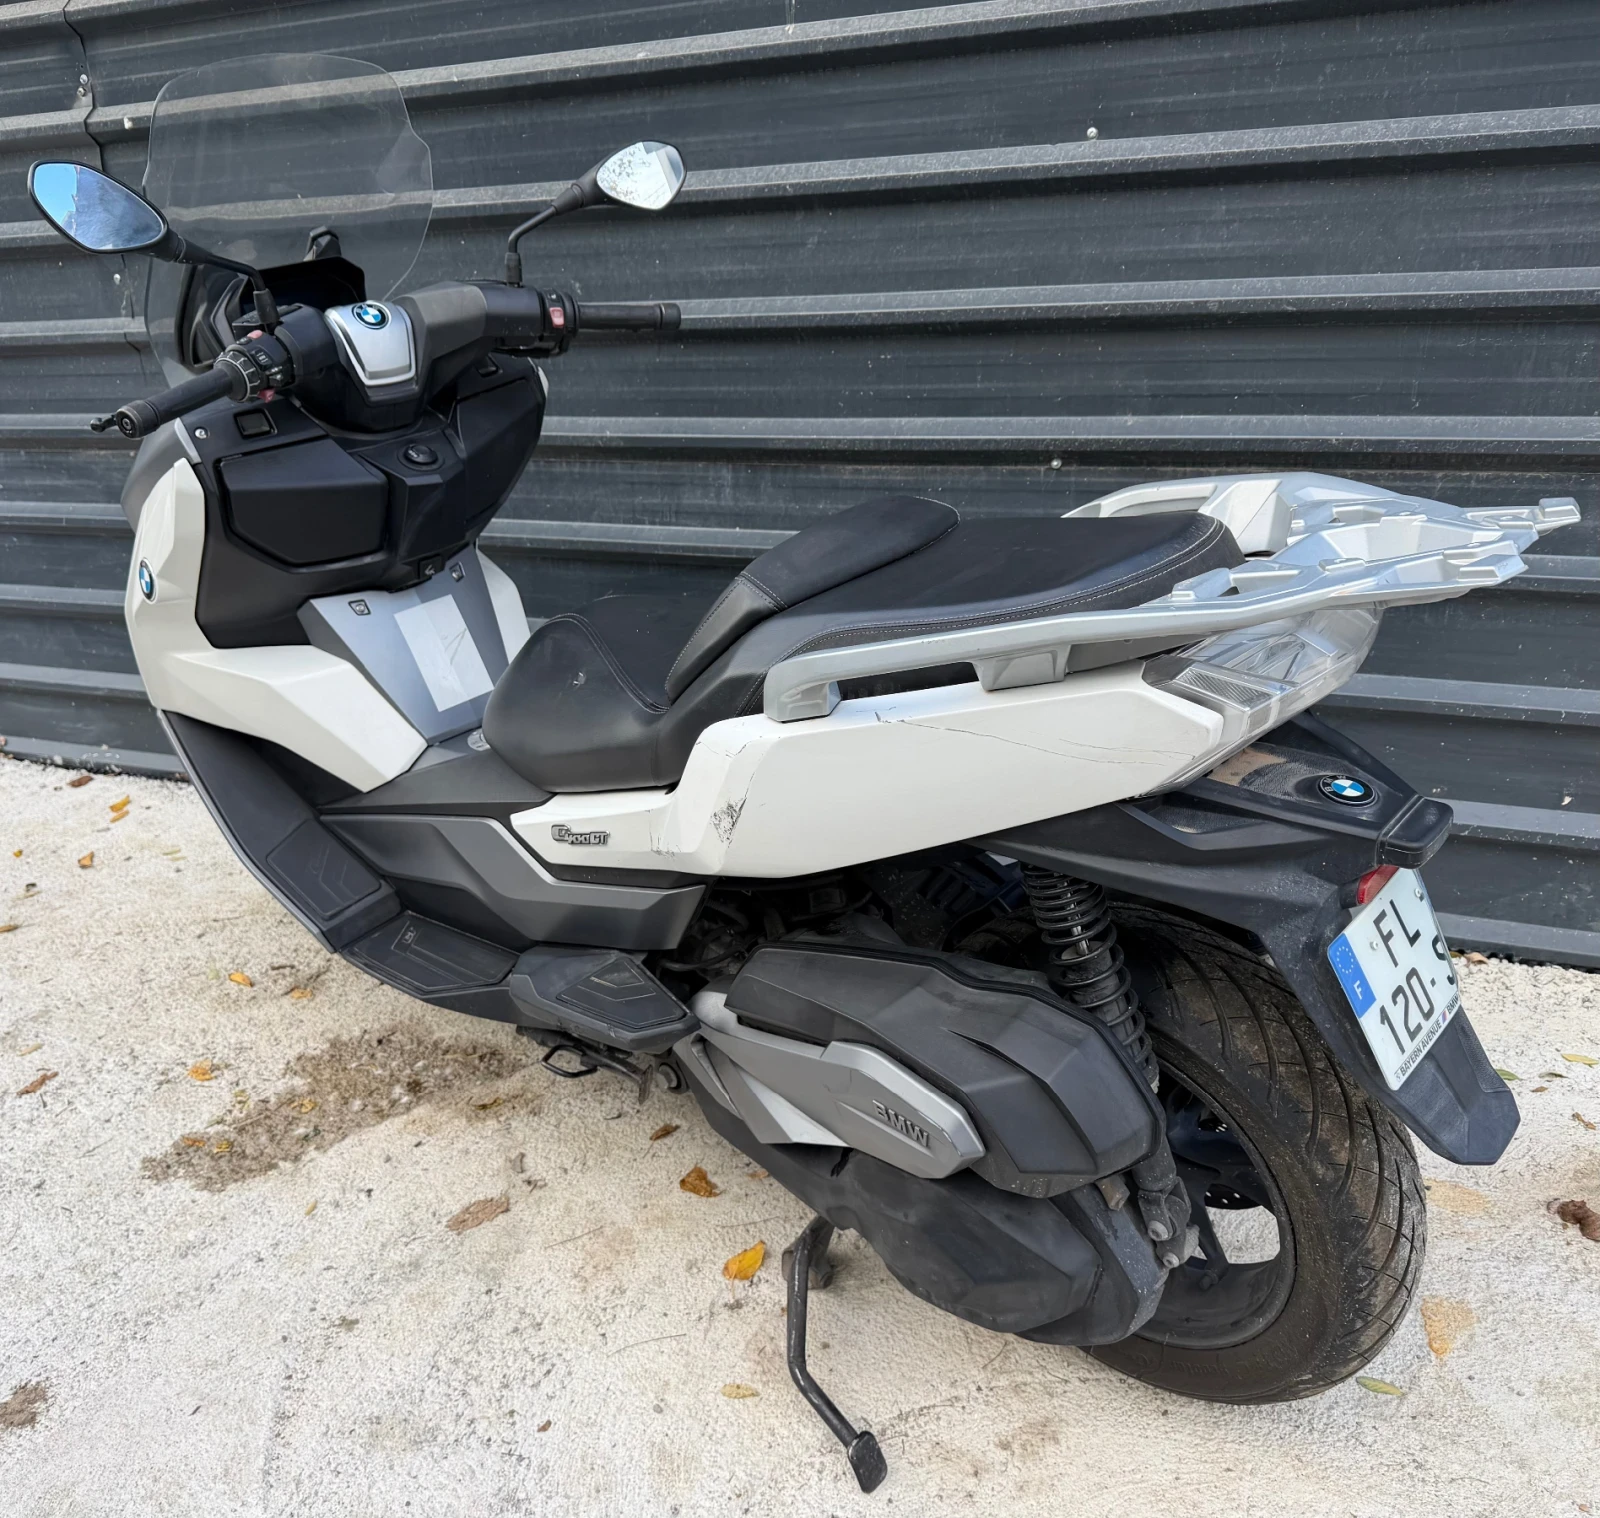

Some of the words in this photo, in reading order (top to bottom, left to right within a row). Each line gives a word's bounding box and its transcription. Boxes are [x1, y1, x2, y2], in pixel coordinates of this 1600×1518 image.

[1353, 980, 1362, 999] F
[1399, 1045, 1423, 1077] BAYERN
[1421, 1019, 1442, 1051] AVENUE
[873, 1100, 928, 1147] BMW
